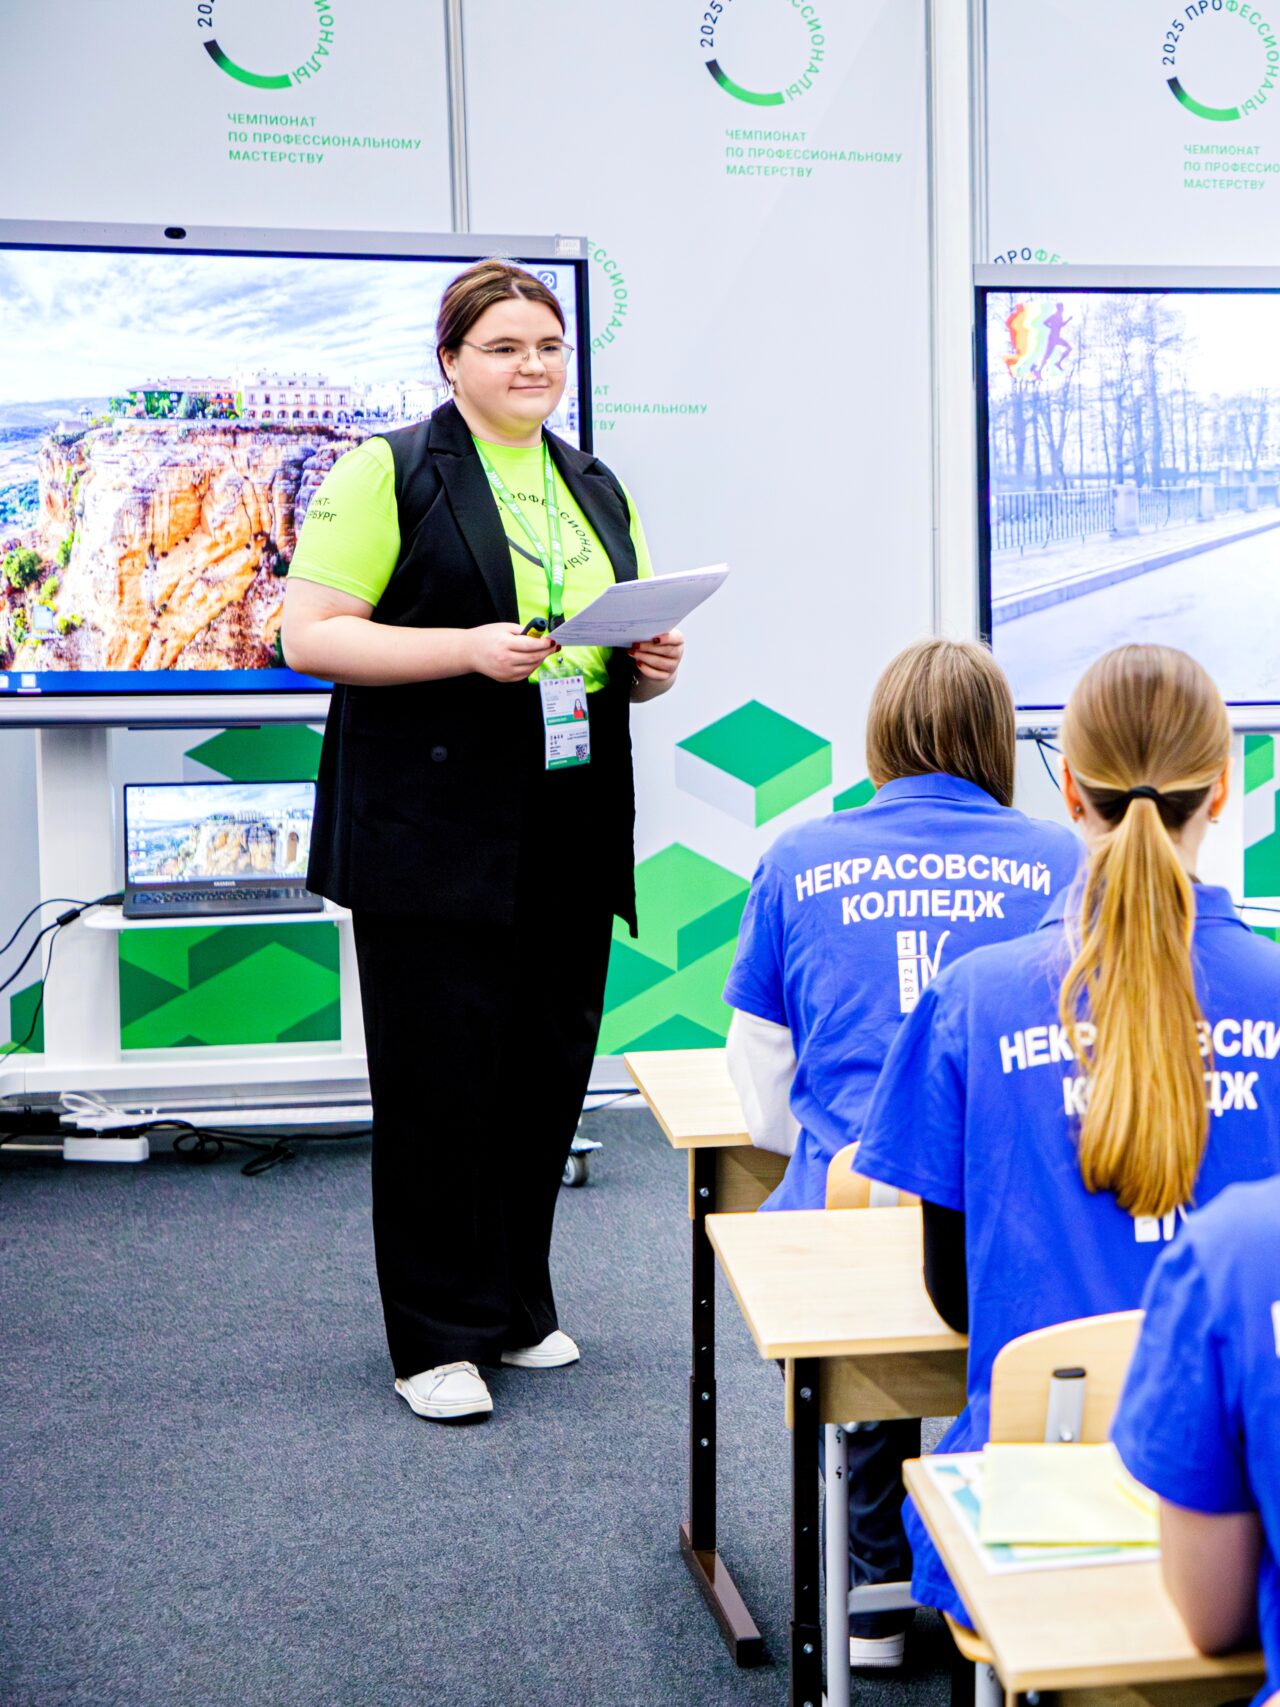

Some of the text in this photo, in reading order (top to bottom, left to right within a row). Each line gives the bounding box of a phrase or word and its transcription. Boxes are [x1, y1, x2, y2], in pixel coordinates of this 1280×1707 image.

[700, 0, 723, 47] 2025
[1162, 0, 1279, 115] 2025 ПРОФЕССИОНАЛЫ
[227, 112, 317, 128] ЧЕМПИОНАТ
[227, 131, 422, 151] ПО ПРОФЕССИОНАЛЬНОМУ
[725, 129, 806, 142] ЧЕМПИОНАТ
[228, 149, 324, 164] МАСТЕРСТВУ
[725, 147, 902, 162] ПО ПРОФЕССИОНАЛЬНОМУ
[1183, 144, 1260, 155] ЧЕМПИОНАТ
[725, 164, 813, 177] МАСТЕРСТВУ
[1183, 161, 1201, 172] ПО
[1183, 178, 1265, 190] МАСТЕРСТВУ
[594, 402, 708, 414] ССИОНАЛЬНОМУ
[795, 853, 1051, 902] НЕКРАСОВСКИЙ
[841, 888, 1005, 925] КОЛЛЕДЖ
